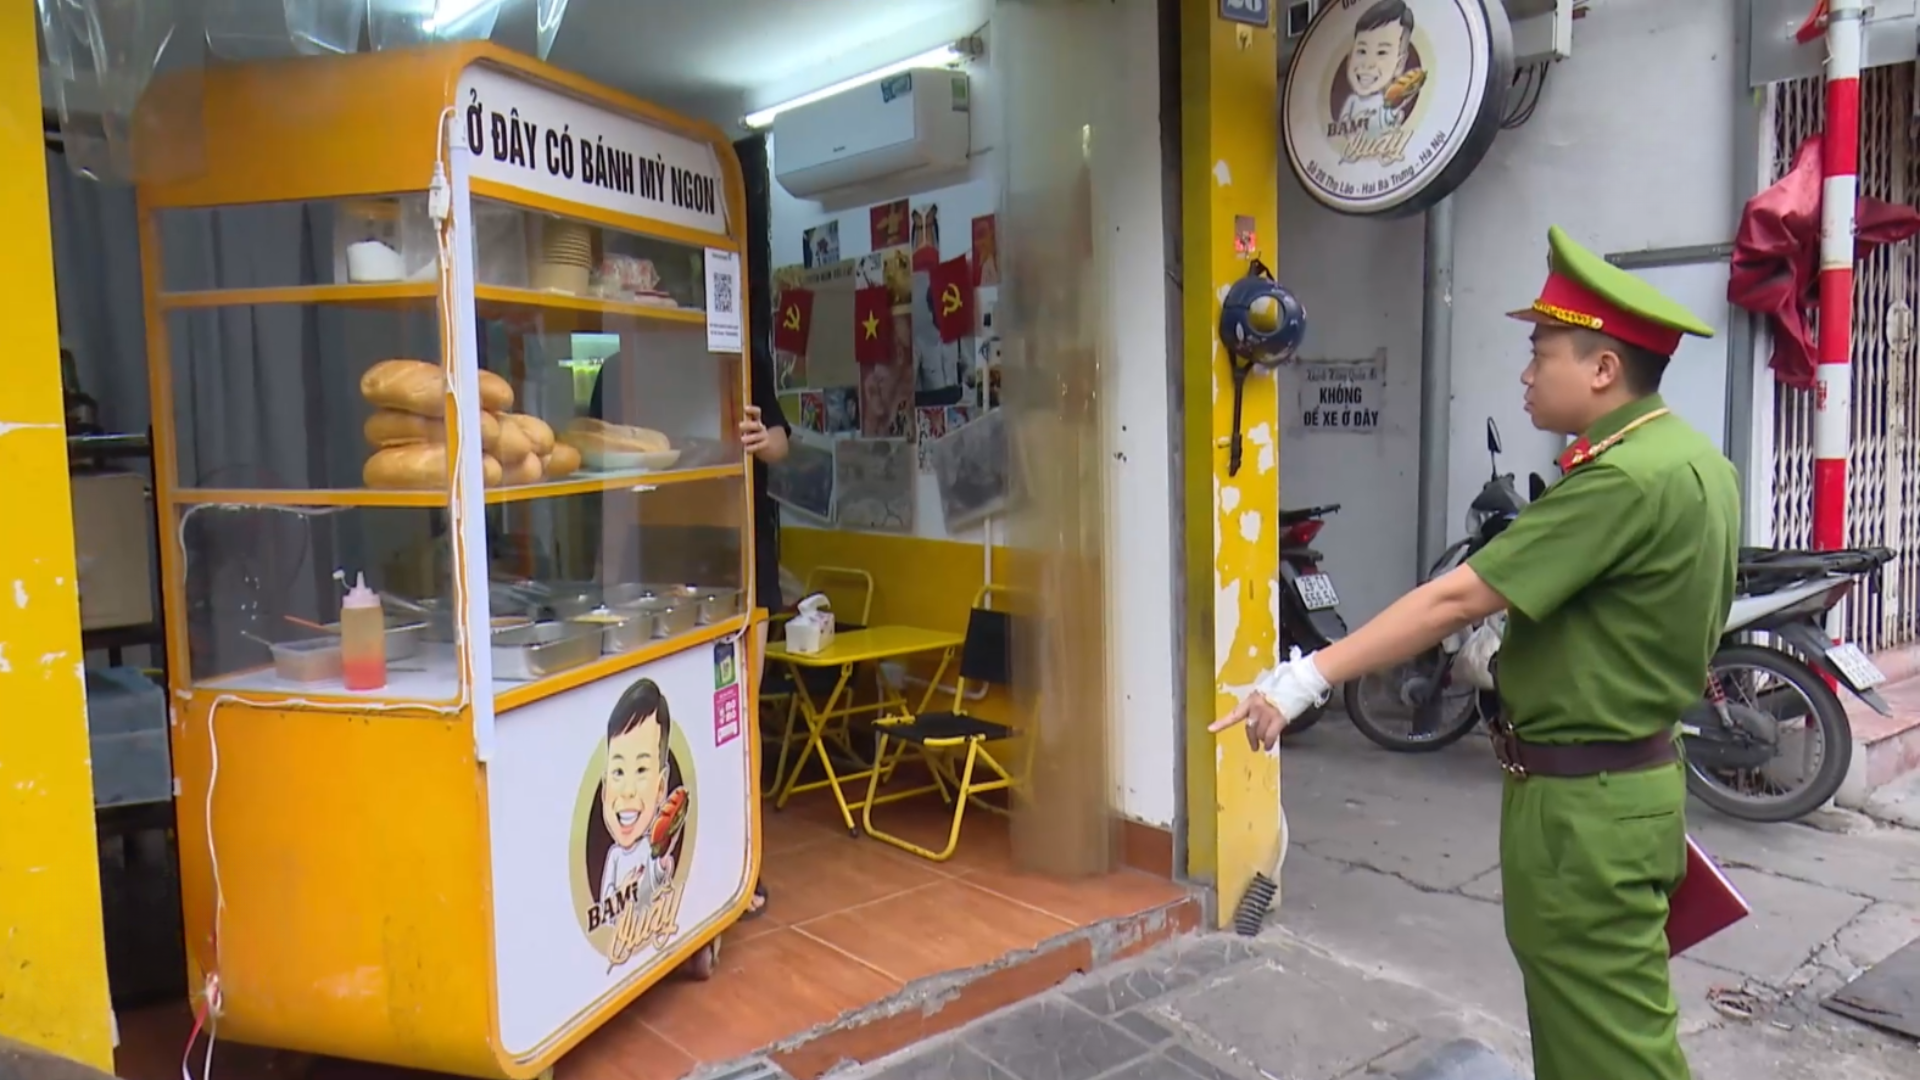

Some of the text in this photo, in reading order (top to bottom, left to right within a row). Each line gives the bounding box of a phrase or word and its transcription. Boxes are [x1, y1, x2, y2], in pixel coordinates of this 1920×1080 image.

[466, 87, 484, 156] Ở
[490, 107, 537, 170] ĐÂY
[545, 124, 575, 180] CÓ
[580, 135, 635, 195] BÁNH
[670, 166, 716, 216] NGON
[1319, 383, 1363, 404] KHÔNG
[1323, 410, 1338, 427] XE
